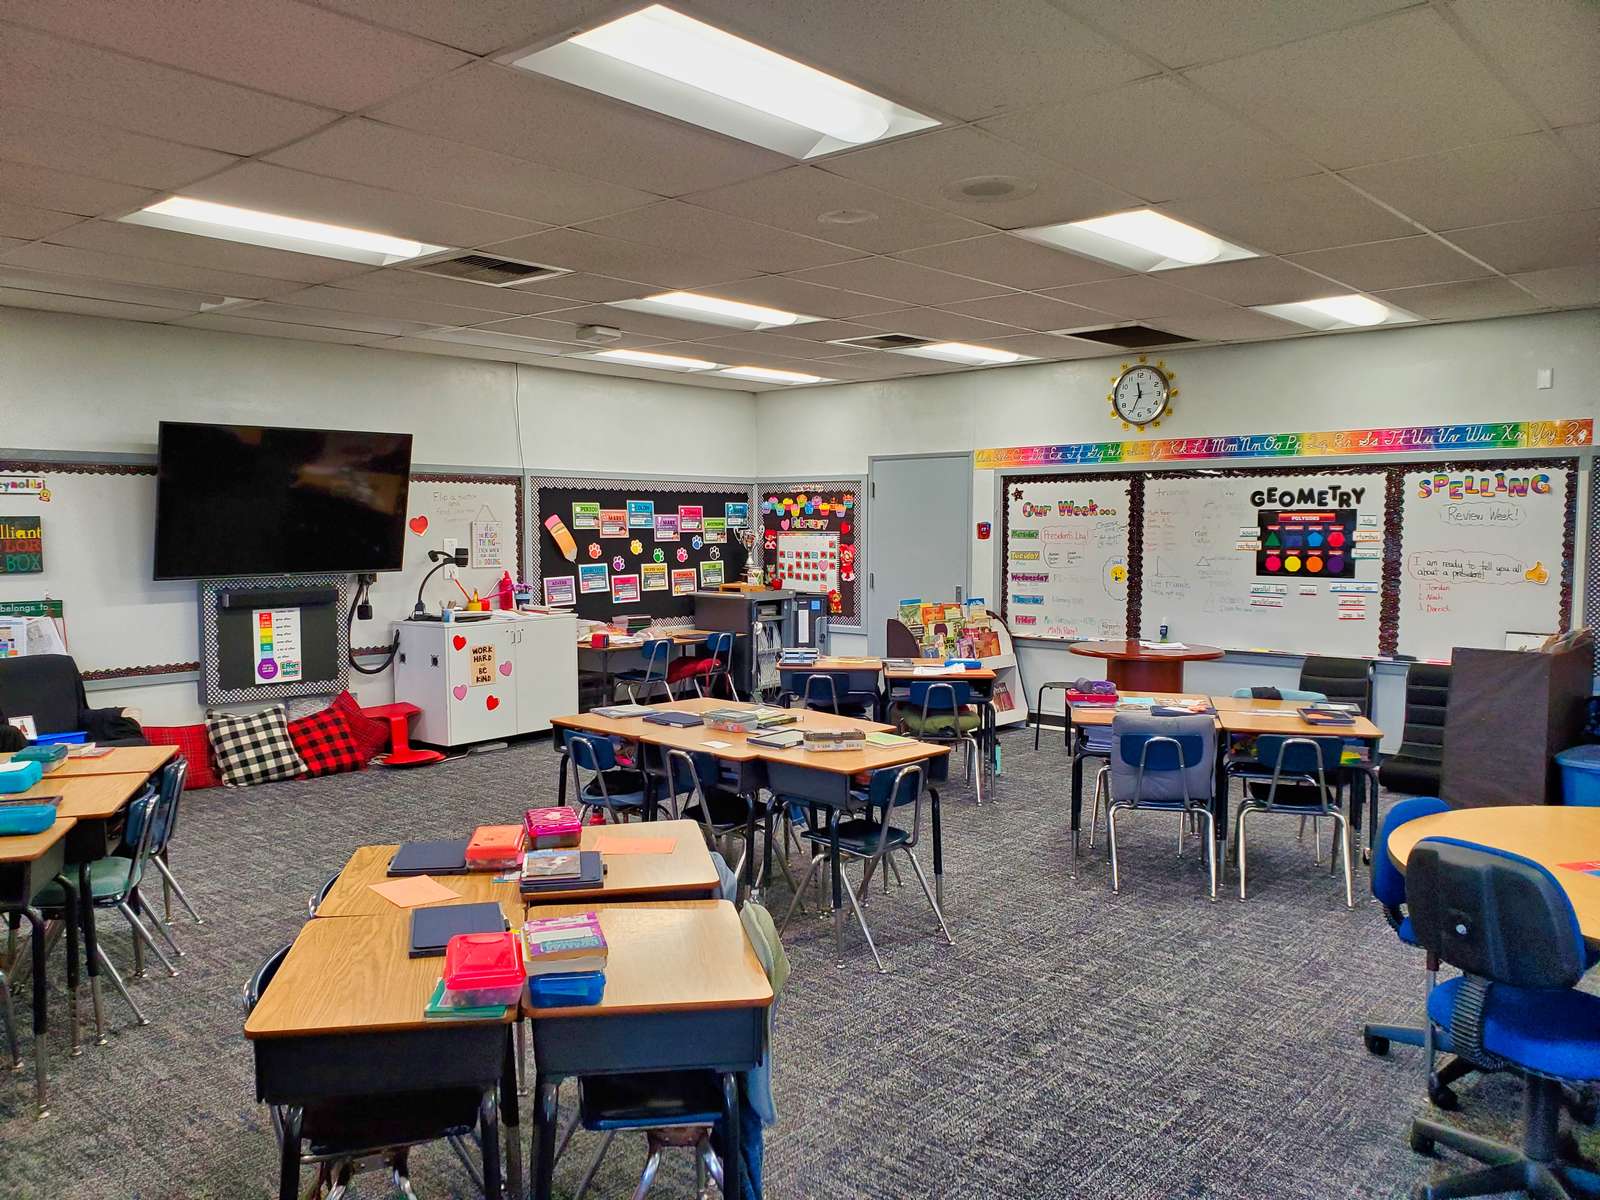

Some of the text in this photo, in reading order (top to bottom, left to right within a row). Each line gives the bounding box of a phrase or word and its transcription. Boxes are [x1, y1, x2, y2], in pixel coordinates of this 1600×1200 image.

[1212, 438, 1238, 453] Mm
[1240, 436, 1264, 451] Nn
[1264, 436, 1281, 450] Oo
[1287, 435, 1303, 456] Pp
[1412, 428, 1434, 445] Uu
[1438, 427, 1460, 443] Vv
[1466, 425, 1498, 442] Ww
[1417, 473, 1553, 499] SPELLING
[1250, 485, 1366, 508] GEOMETRY
[1022, 501, 1052, 518] Our
[1448, 506, 1519, 521] Review Week!
[790, 516, 829, 530] February
[1011, 551, 1039, 560] Tuesday
[7, 554, 42, 572] BOX
[1442, 559, 1463, 569] ready
[1465, 560, 1476, 570] to
[1479, 560, 1492, 571] tell
[1496, 566, 1510, 576] you
[1512, 563, 1522, 573] all
[1011, 573, 1049, 582] Wednesday
[1417, 568, 1439, 577] about
[472, 646, 493, 654] WORK
[473, 654, 492, 663] HARD
[476, 675, 492, 683] KIND
